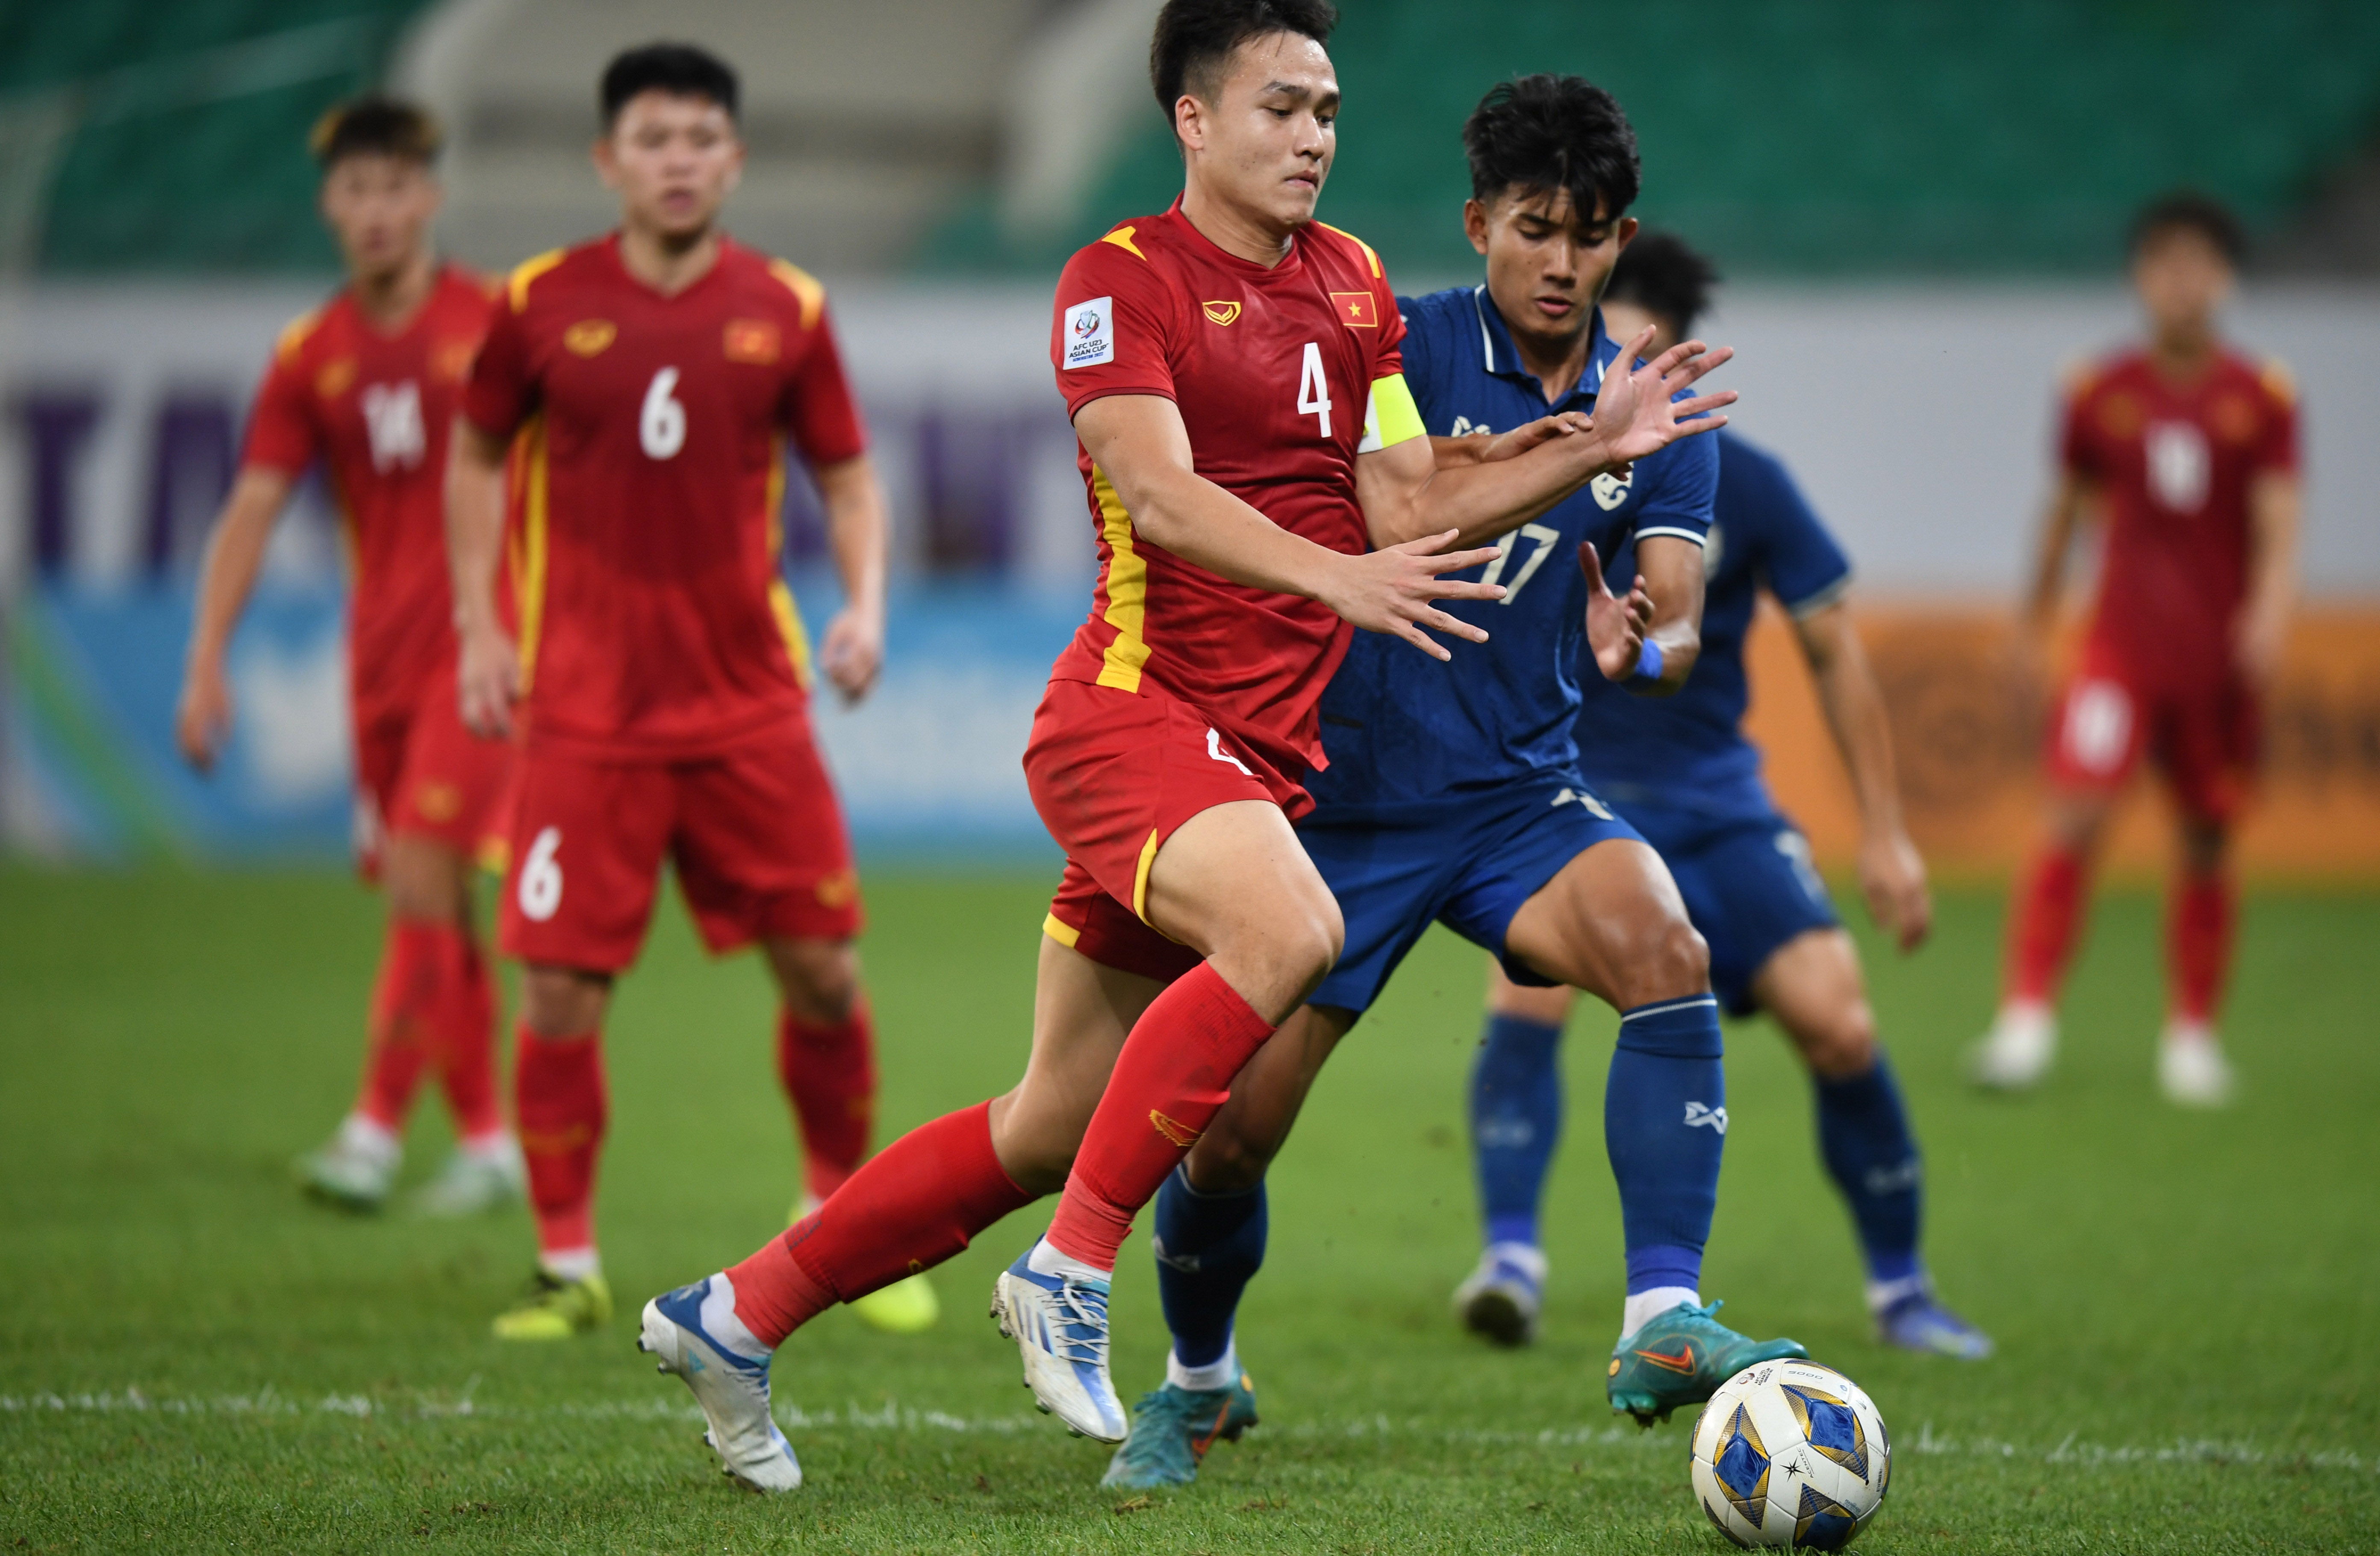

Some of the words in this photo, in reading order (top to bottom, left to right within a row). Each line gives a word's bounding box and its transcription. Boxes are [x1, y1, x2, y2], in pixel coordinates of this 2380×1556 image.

[1069, 349, 1091, 358] ASIAN
[1092, 344, 1107, 353] CUP
[1073, 343, 1087, 351] AFC
[1089, 339, 1102, 347] U23
[360, 379, 425, 476] 14
[639, 365, 686, 461] 6
[1297, 342, 1331, 438] 4
[1480, 522, 1560, 605] 17
[518, 825, 563, 922] 6
[1797, 1447, 1814, 1478] ACENTEC
